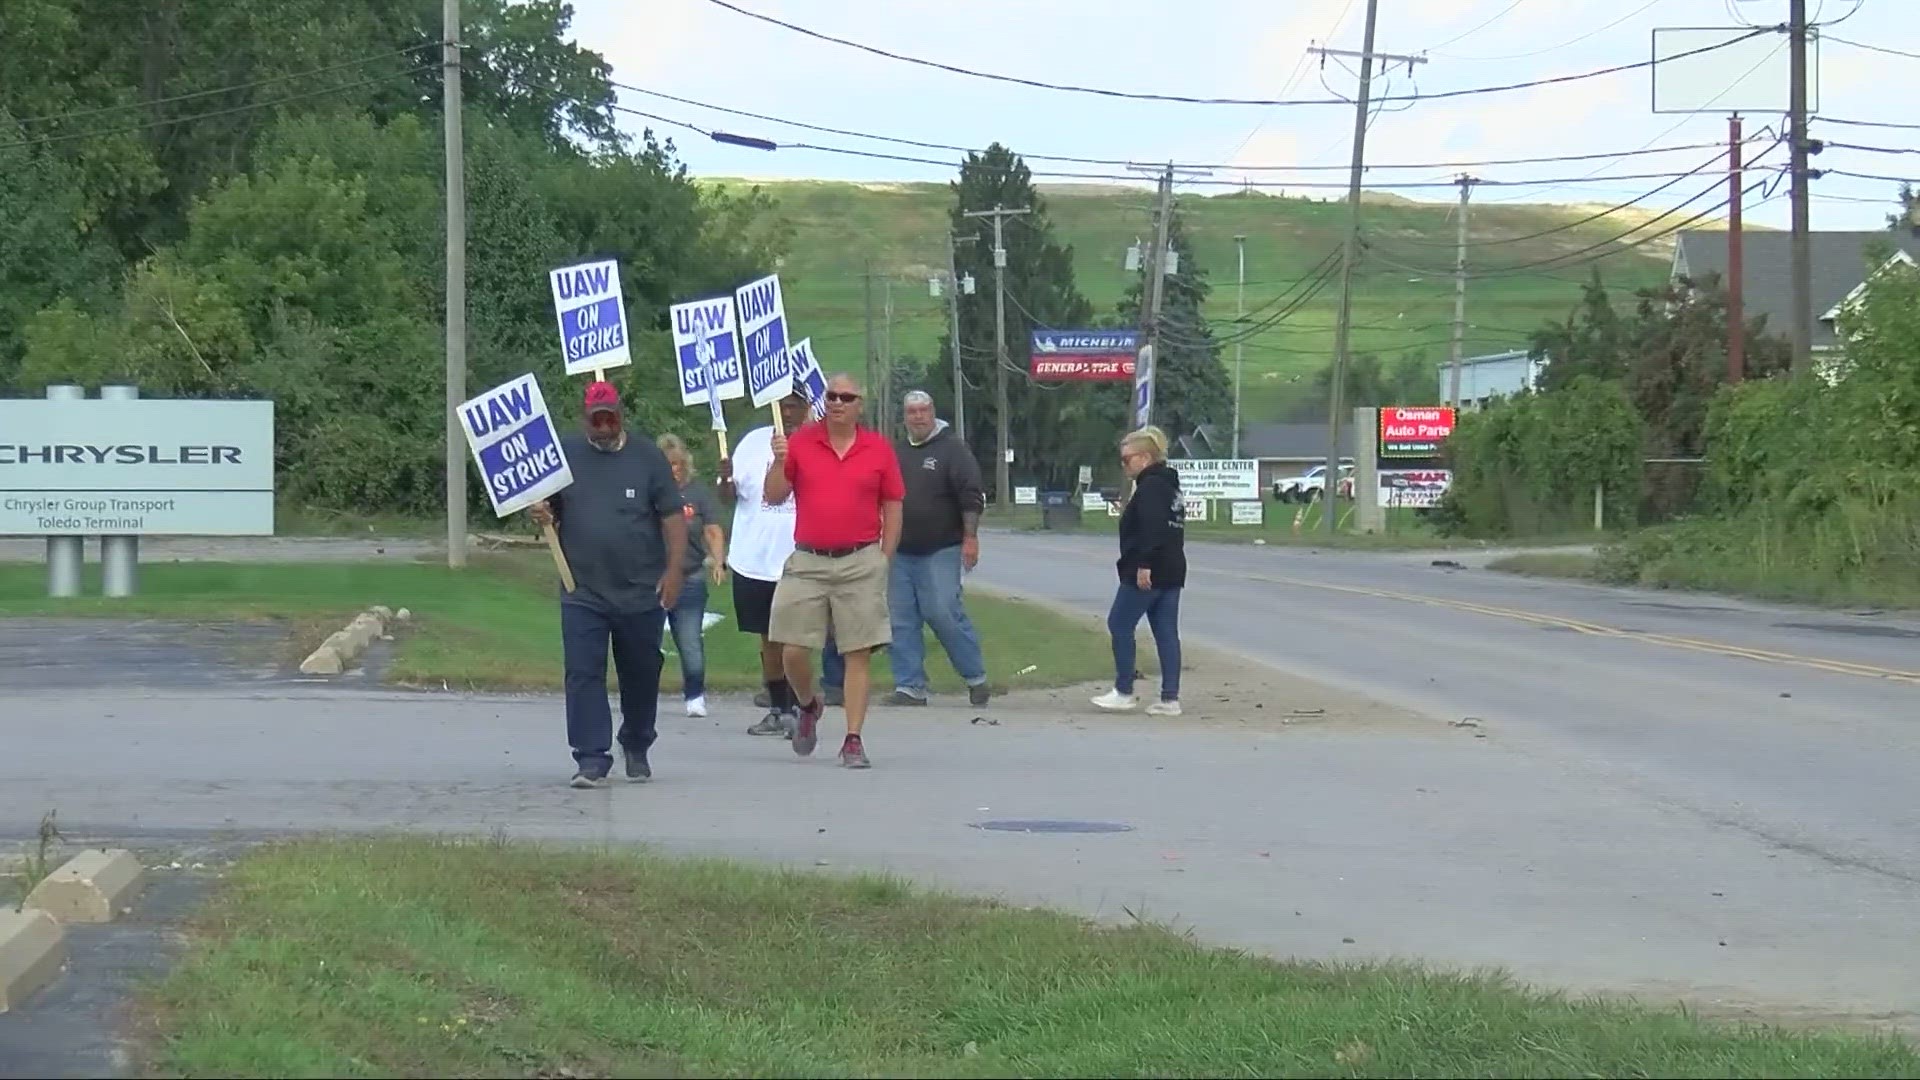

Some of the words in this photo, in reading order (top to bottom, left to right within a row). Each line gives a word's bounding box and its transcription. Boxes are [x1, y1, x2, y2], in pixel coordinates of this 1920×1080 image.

[557, 266, 610, 299] UAW
[740, 281, 775, 323] UAW
[577, 304, 599, 331] ON
[677, 303, 726, 334] UAW
[570, 323, 621, 359] STRIKE
[755, 327, 770, 358] ON
[1060, 337, 1135, 347] MICHELIN
[752, 347, 787, 391] STRIKE
[1036, 363, 1090, 373] GENERAL
[1091, 363, 1119, 373] TIRE
[466, 383, 532, 437] UAW
[1396, 410, 1440, 420] Osman
[1386, 425, 1415, 436] Auto
[1418, 425, 1450, 436] Parts
[501, 433, 529, 463] ON
[493, 443, 559, 496] STRIKE
[1198, 461, 1219, 470] LUBE
[1222, 461, 1254, 470] CENTER
[4, 499, 59, 514] Chrysler
[64, 499, 107, 514] Group
[110, 499, 175, 514] Transport
[37, 517, 80, 529] Toledo
[84, 517, 143, 529] Terminal
